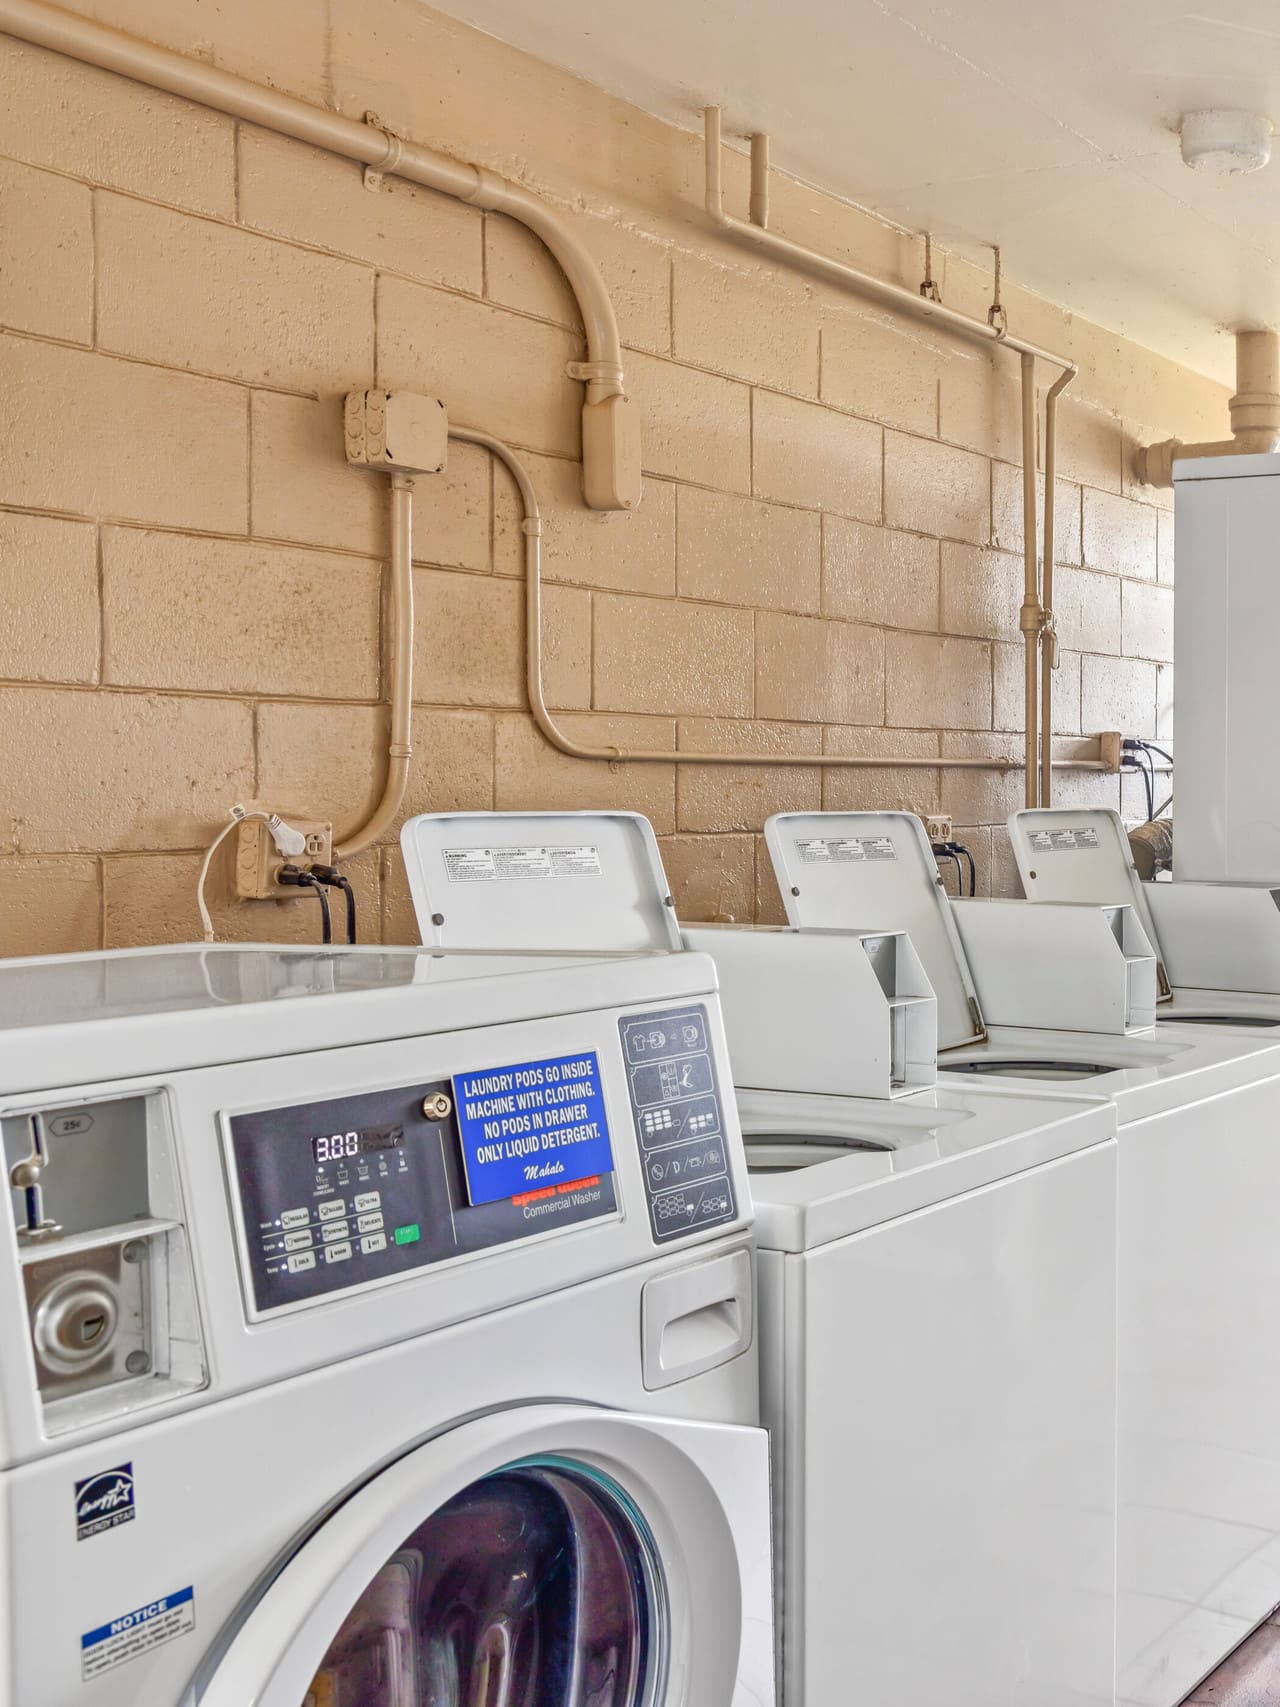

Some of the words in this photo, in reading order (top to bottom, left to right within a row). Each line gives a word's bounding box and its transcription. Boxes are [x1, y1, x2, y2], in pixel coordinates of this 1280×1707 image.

[464, 1074, 513, 1097] LAUNDRY
[515, 1069, 544, 1088] PODS
[545, 1066, 560, 1082] GO
[561, 1060, 593, 1080] INSIDE
[465, 1096, 516, 1120] MACHINE
[516, 1091, 543, 1110] WITH
[545, 1081, 595, 1104] CLOTHING.
[484, 1121, 500, 1140] NO
[501, 1115, 531, 1136] PODS
[532, 1112, 543, 1129] IN
[544, 1104, 588, 1127] DRAWER
[476, 1143, 506, 1164] ONLY
[505, 1136, 540, 1158] LIQUID
[541, 1123, 600, 1150] DETERGENT.
[523, 1160, 565, 1180] Mahalo
[523, 1198, 571, 1219] Commercial
[572, 1189, 601, 1206] Washer
[110, 1599, 167, 1634] NOTICE
